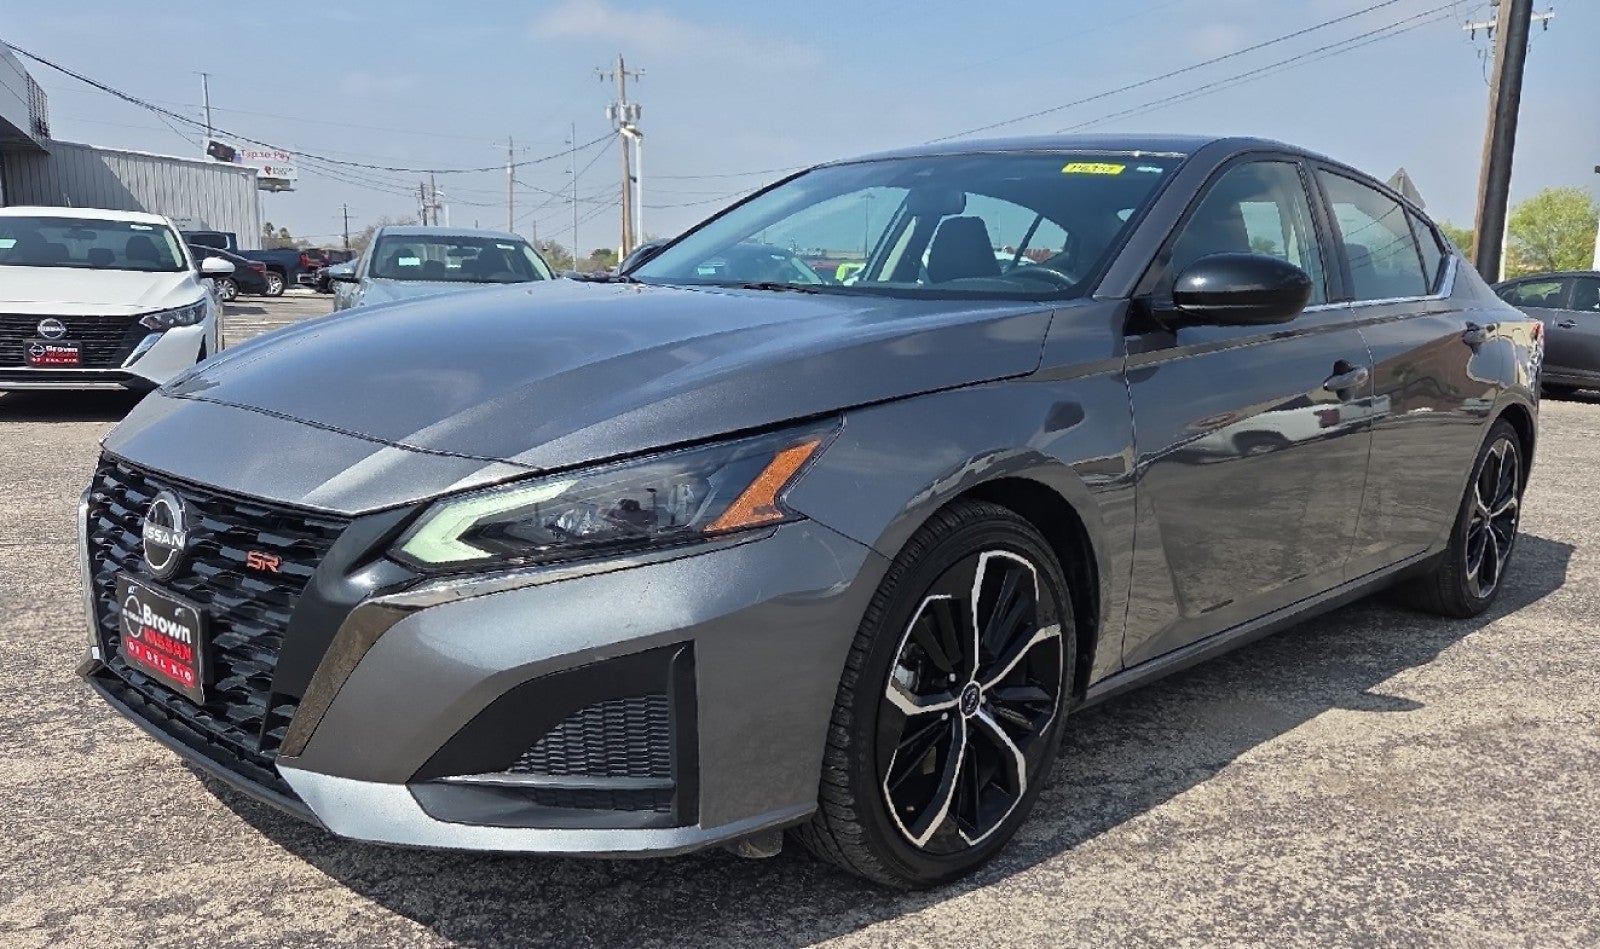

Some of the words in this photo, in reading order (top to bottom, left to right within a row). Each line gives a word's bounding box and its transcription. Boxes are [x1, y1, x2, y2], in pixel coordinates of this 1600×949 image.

[247, 550, 279, 573] SR
[143, 603, 192, 644] Brown
[143, 626, 193, 664] NISSAN
